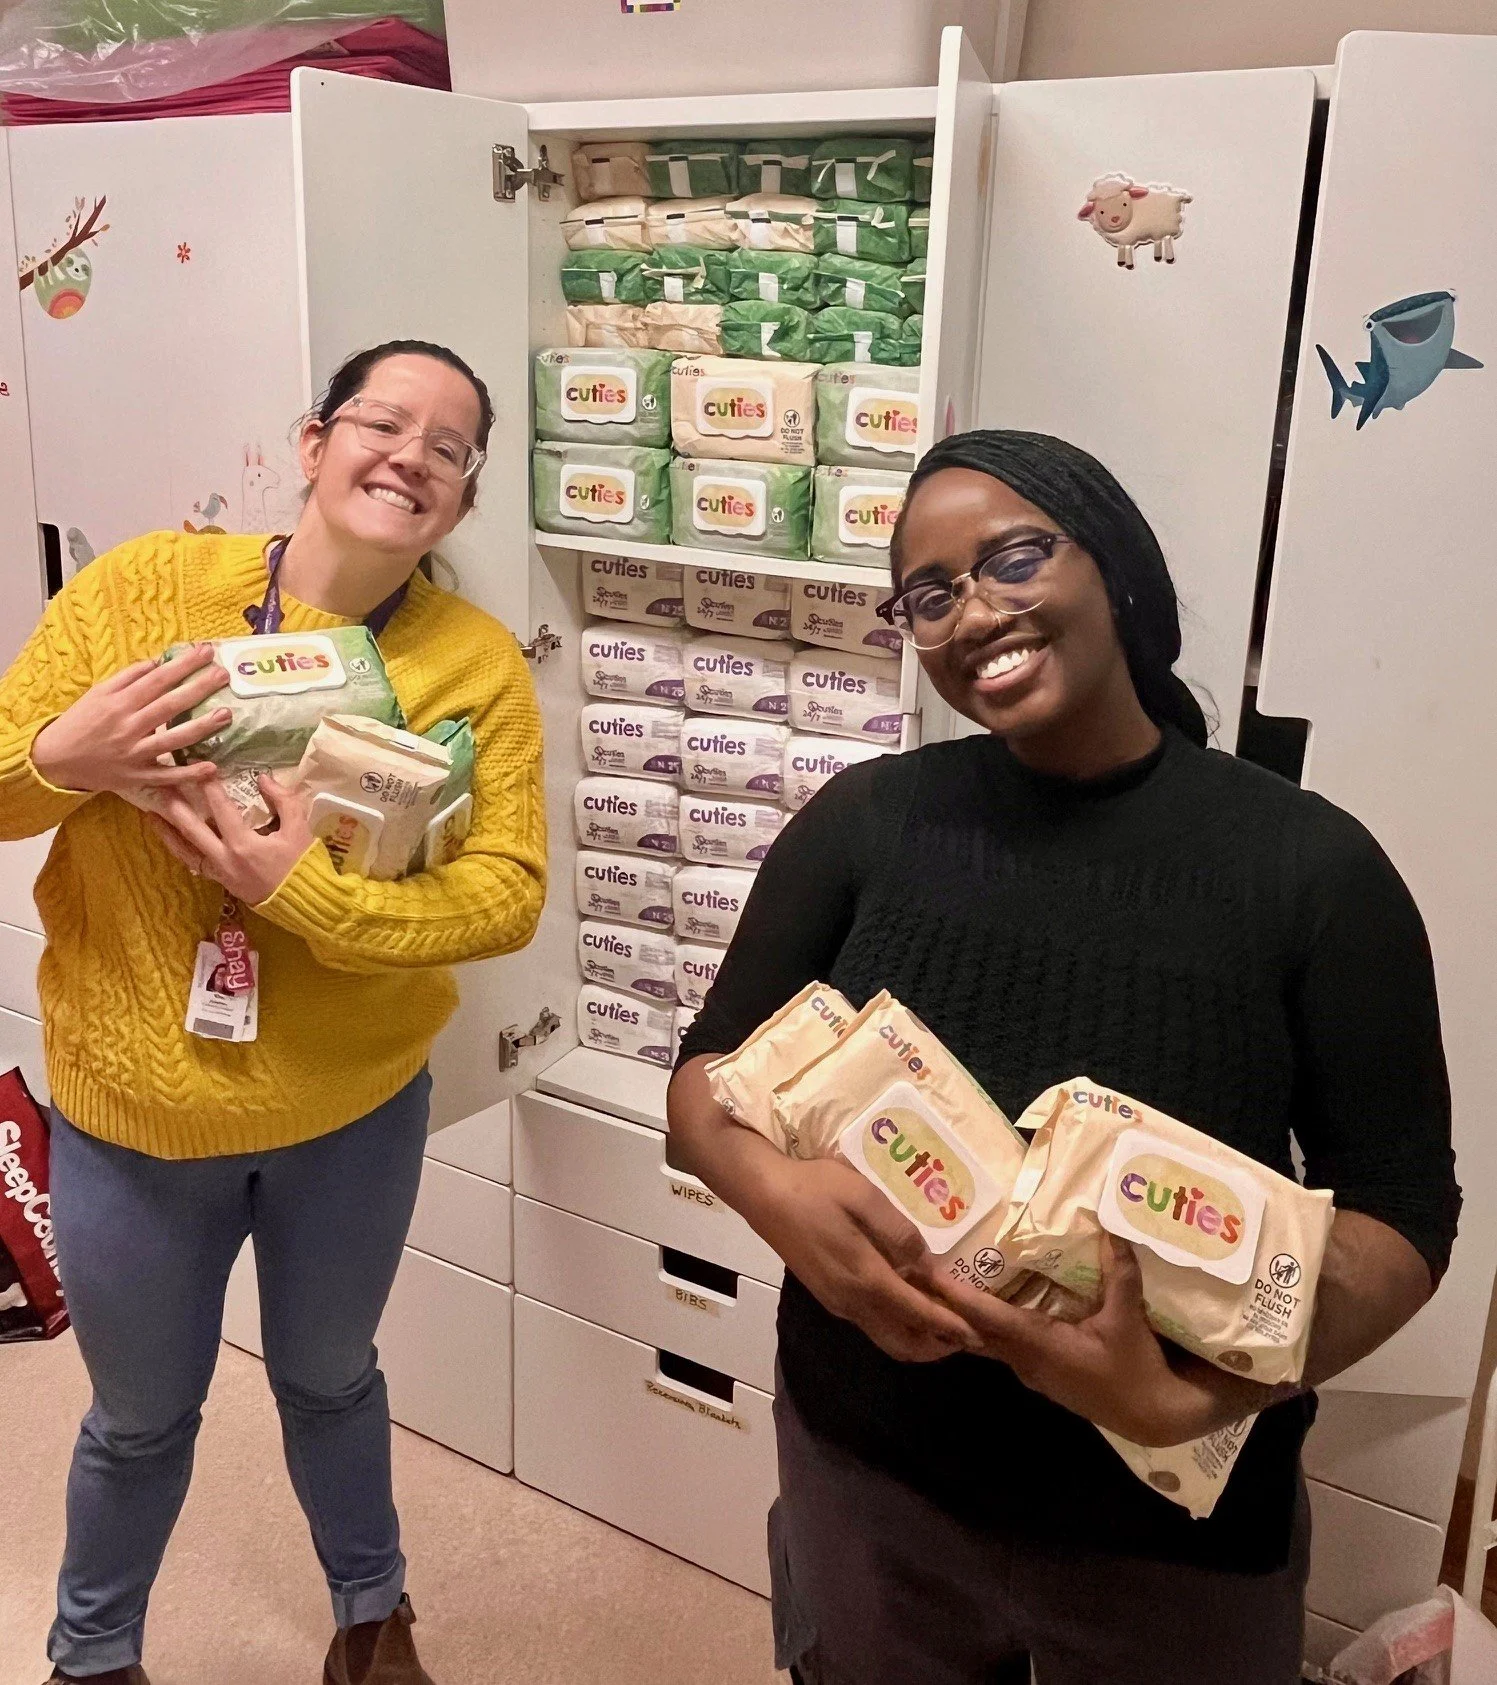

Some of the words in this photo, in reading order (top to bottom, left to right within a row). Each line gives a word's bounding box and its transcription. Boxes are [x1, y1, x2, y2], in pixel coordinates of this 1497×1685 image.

[540, 352, 570, 365] uties
[672, 364, 706, 378] cuties
[565, 383, 627, 404] cuties
[703, 397, 766, 419] cuties
[565, 484, 625, 506] cuties
[697, 496, 755, 518] cuties
[845, 504, 899, 526] cutie
[591, 557, 649, 579] cuties
[696, 570, 755, 590] cuties
[803, 582, 868, 607] cuties
[589, 641, 646, 662] cuties
[237, 652, 330, 676] cuties
[693, 654, 754, 677] cuties
[802, 670, 867, 695] cuties
[589, 717, 644, 738] cuties
[687, 734, 747, 756] cuties
[792, 755, 850, 775] cutie
[583, 795, 638, 816] cuties
[689, 806, 747, 828] cuties
[330, 815, 359, 872] uties
[584, 865, 638, 887] cuties
[681, 890, 739, 912] cuties
[582, 933, 633, 958] cuties
[221, 930, 250, 989] Shay
[682, 960, 719, 981] cuti
[586, 1001, 640, 1025] cuties
[811, 996, 848, 1038] cuti
[879, 1024, 932, 1080] cuties
[1072, 1090, 1143, 1123] cuties
[871, 1117, 965, 1221] cuties
[671, 1184, 714, 1207] WIPES
[1120, 1172, 1242, 1244] cuties
[954, 1256, 971, 1275] DO
[675, 1288, 707, 1311] BIBS
[1254, 1278, 1273, 1298] DO
[1273, 1285, 1301, 1309] NOT
[1254, 1294, 1292, 1320] FLUSH
